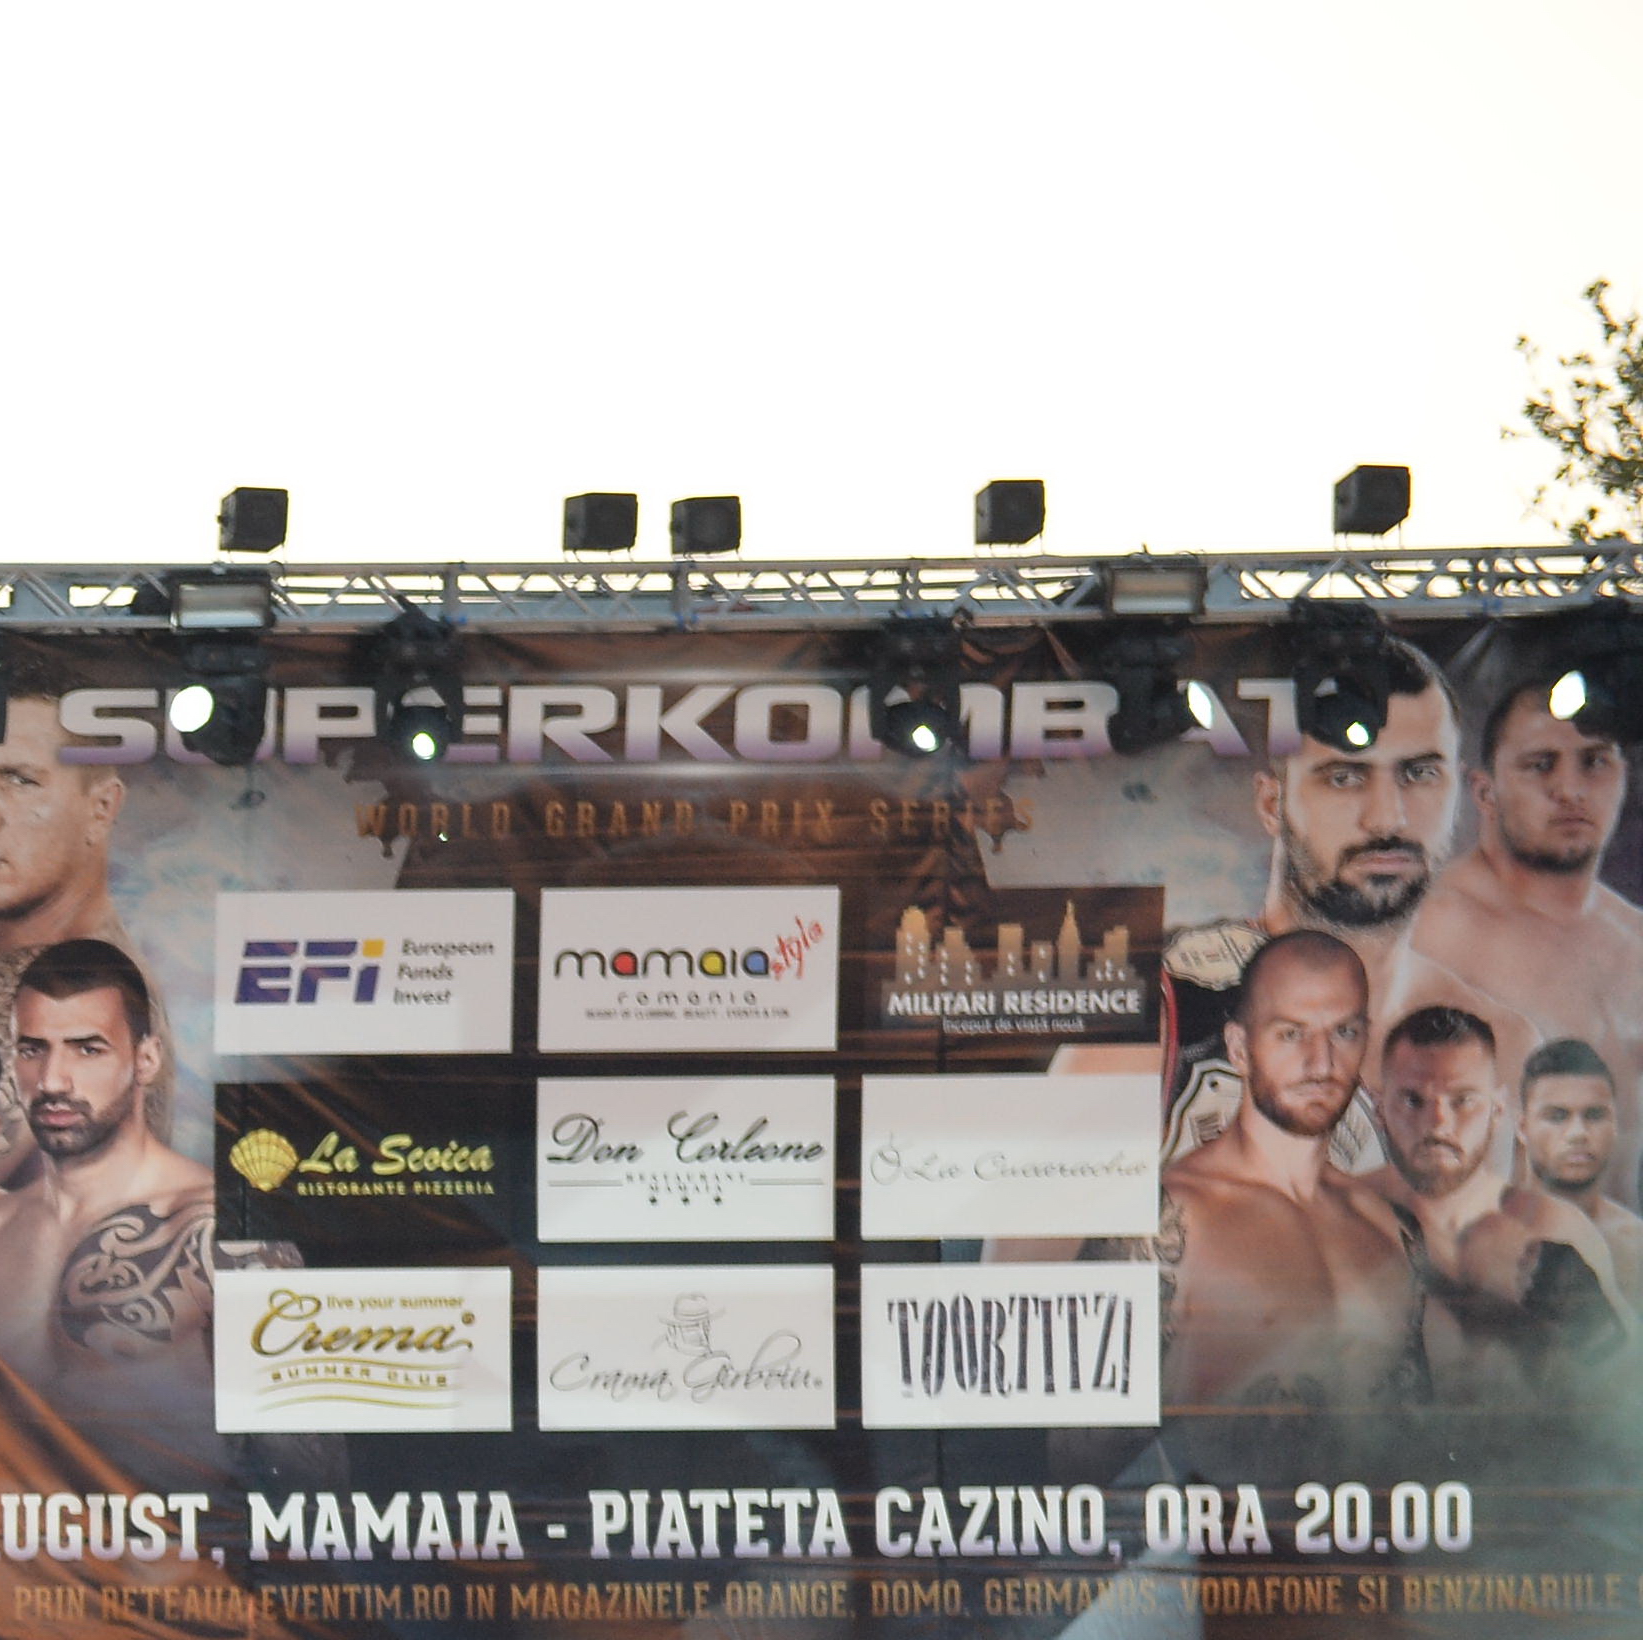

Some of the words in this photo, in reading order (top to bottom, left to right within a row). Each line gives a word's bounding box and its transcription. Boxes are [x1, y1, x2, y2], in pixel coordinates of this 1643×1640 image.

[355, 800, 512, 839] WORLD
[543, 800, 696, 838] GRAND
[729, 799, 834, 837] PRIX
[869, 797, 1036, 837] SERIES
[401, 938, 495, 958] European
[397, 963, 455, 981] Funds
[553, 947, 770, 980] mamaia
[393, 987, 452, 1006] Invest
[886, 989, 996, 1016] MILITARI
[1002, 988, 1142, 1014] RESIDENCE
[546, 1112, 645, 1164] Don
[667, 1110, 826, 1164] Corleone
[298, 1131, 360, 1174] La
[296, 1181, 407, 1197] RISTORANTE
[414, 1181, 495, 1196] PIZZERIA
[326, 1295, 354, 1309] live
[359, 1297, 394, 1313] your
[399, 1296, 466, 1309] summer
[250, 1287, 474, 1358] Crema
[386, 1371, 448, 1387] CLUB
[247, 1490, 525, 1561] MAMAIA
[588, 1487, 853, 1560] PIATETA
[874, 1484, 1123, 1565] CAZINO,
[1144, 1482, 1273, 1556] ORA
[1294, 1480, 1474, 1555] 20.00
[14, 1584, 88, 1622] PRIN
[260, 1582, 452, 1622] EVENTIM.RO
[464, 1582, 496, 1621] IN
[510, 1581, 712, 1621] MAGAZINELE
[724, 1579, 857, 1620] ORANGE,
[1181, 1573, 1342, 1616] VODAFONE
[1356, 1572, 1389, 1614] SI
